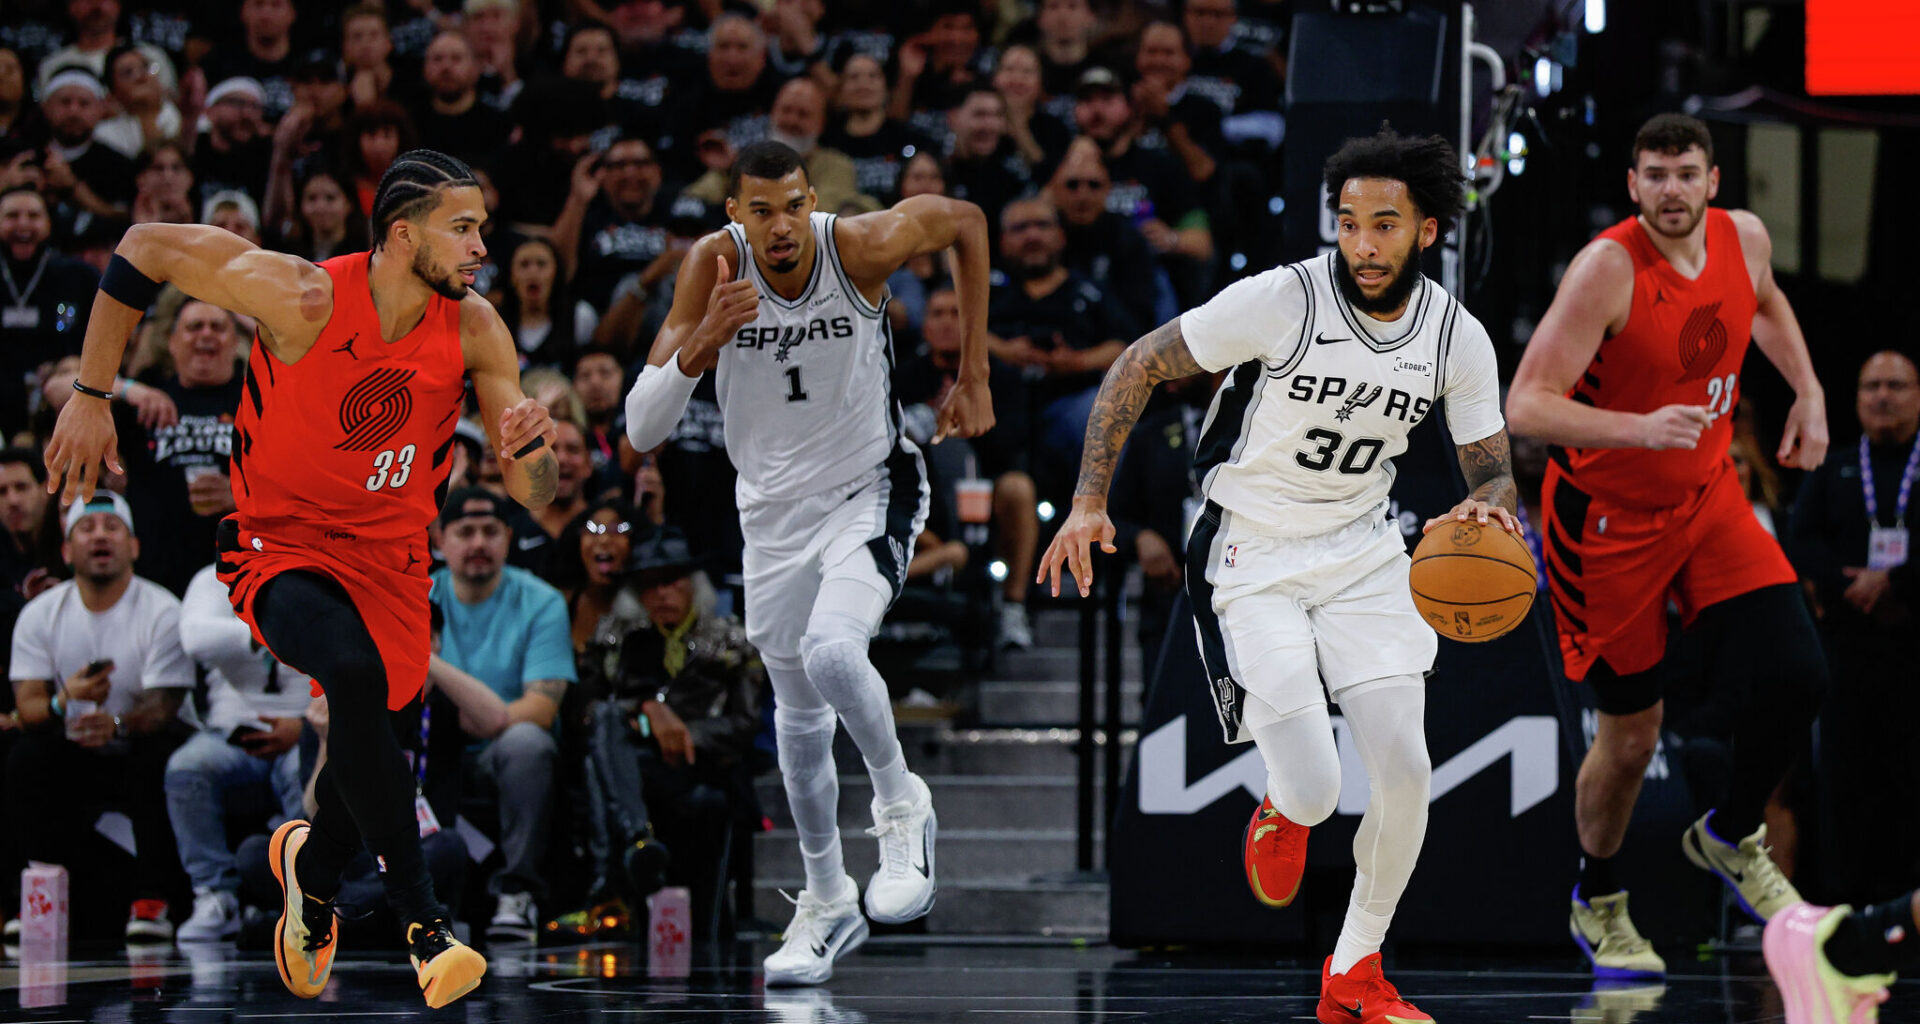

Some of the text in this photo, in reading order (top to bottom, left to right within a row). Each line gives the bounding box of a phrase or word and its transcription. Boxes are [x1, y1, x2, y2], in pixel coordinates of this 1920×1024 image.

[736, 316, 853, 363] SPURS
[784, 365, 808, 403] 1
[1398, 360, 1428, 373] LEDGER
[1288, 374, 1432, 424] SPURS
[1707, 373, 1736, 420] 23
[366, 443, 417, 492] 33
[1294, 425, 1388, 475] 30
